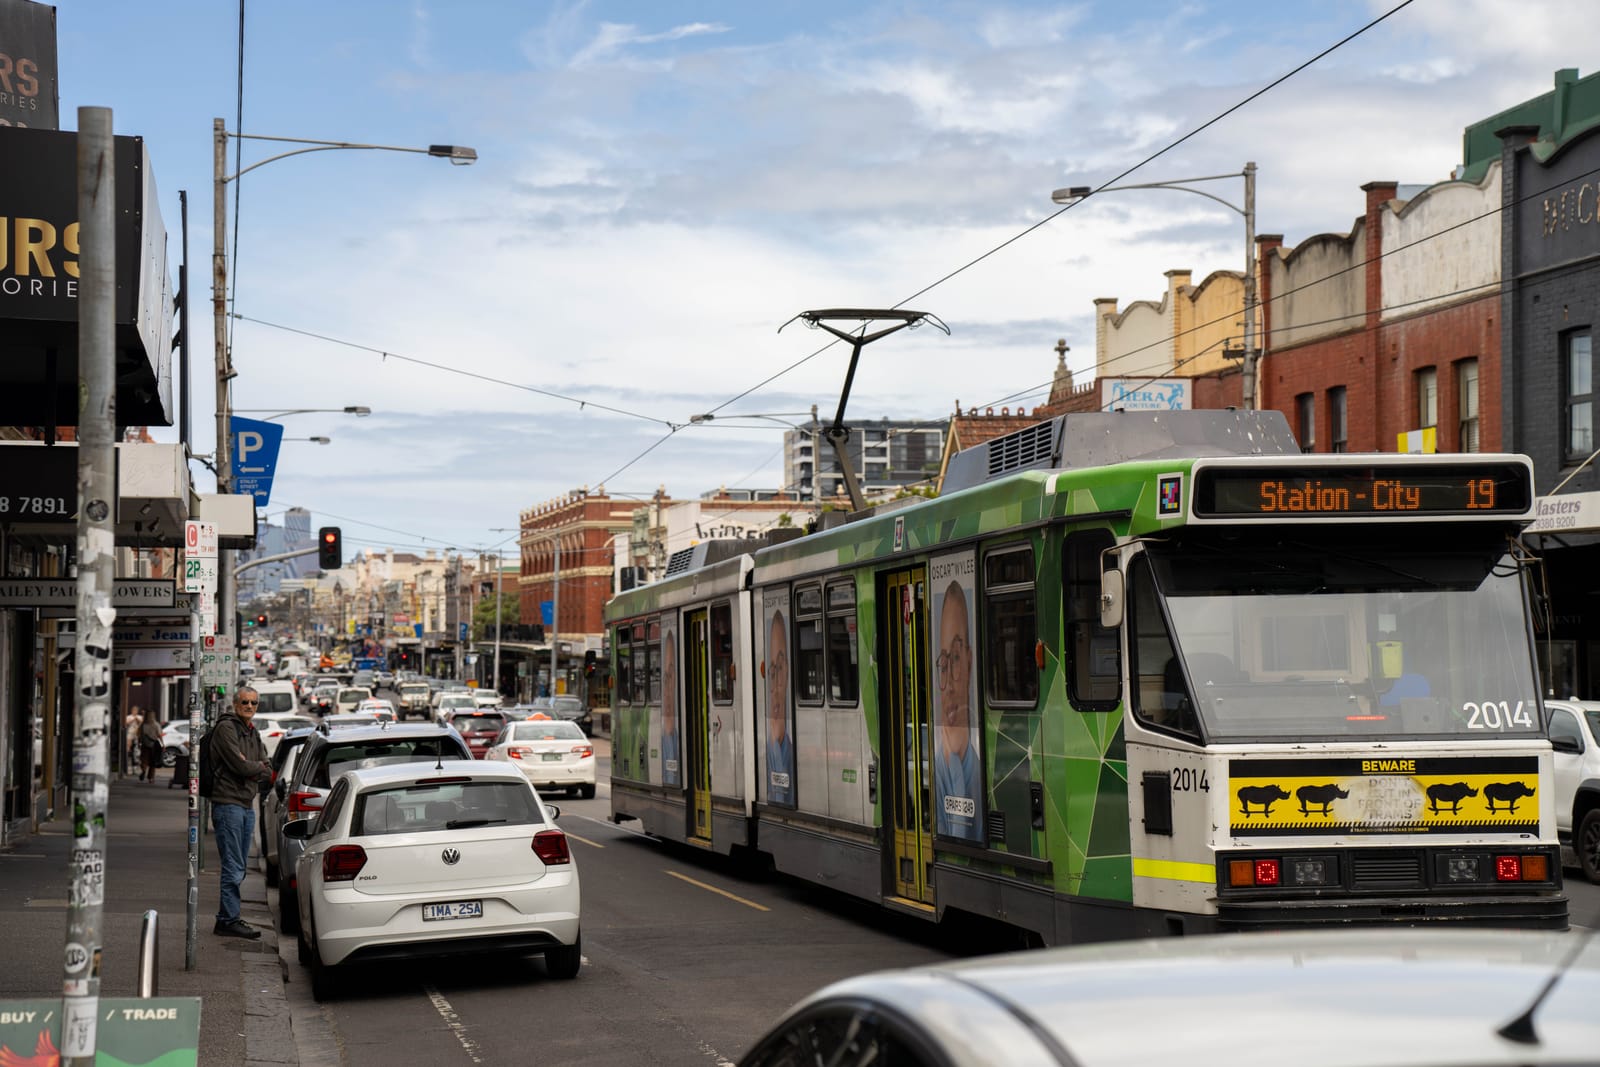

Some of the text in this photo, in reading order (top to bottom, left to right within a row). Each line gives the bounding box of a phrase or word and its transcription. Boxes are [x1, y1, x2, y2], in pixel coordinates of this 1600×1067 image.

[238, 431, 263, 462] P
[19, 497, 67, 514] 7891
[1260, 481, 1349, 511] Station
[1373, 480, 1420, 510] City
[1466, 479, 1494, 509] 19
[186, 561, 200, 577] 2P
[1463, 701, 1532, 729] 2014
[1362, 760, 1416, 771] BEWARE
[1173, 767, 1210, 793] 2014
[1, 1012, 36, 1023] BUY
[123, 1008, 177, 1020] TRADE
